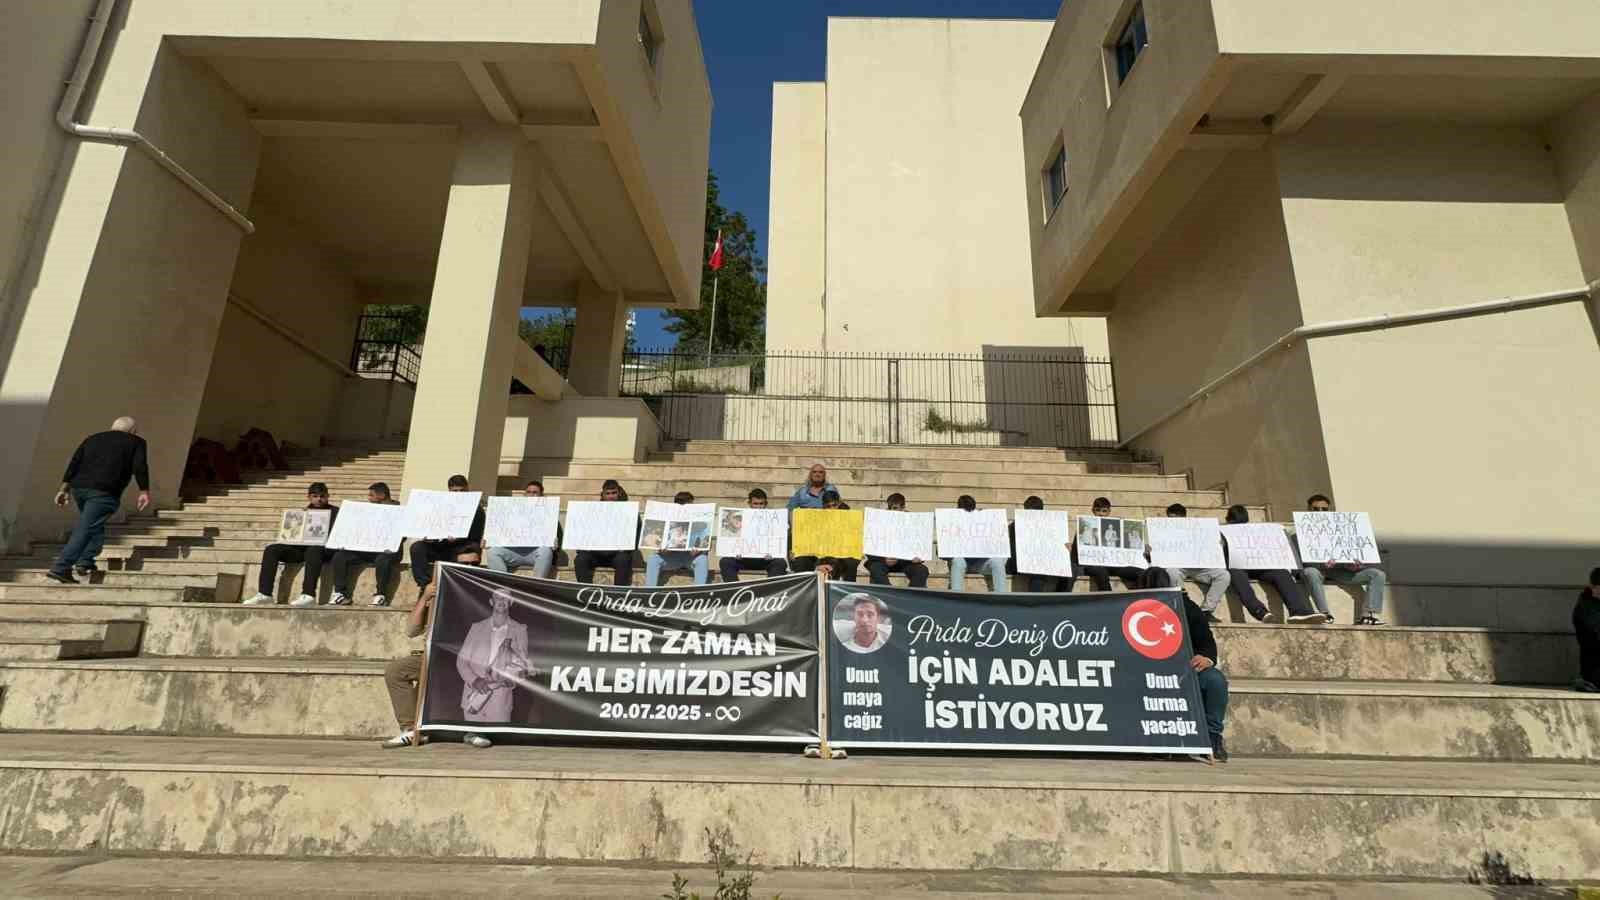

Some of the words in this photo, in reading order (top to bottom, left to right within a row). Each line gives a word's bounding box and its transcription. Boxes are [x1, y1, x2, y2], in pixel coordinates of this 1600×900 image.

[577, 586, 642, 613] Arda
[641, 589, 722, 625] Deniz
[726, 586, 789, 617] Onat
[587, 627, 652, 654] HER
[660, 630, 776, 657] ZAMAN
[907, 615, 972, 646] Arda
[974, 618, 1048, 656] Deniz
[1052, 620, 1109, 649] Onat
[845, 667, 880, 683] Unut
[908, 649, 978, 692] İÇİN
[988, 656, 1115, 687] ADALET
[550, 662, 807, 698] KALBİMİZDESİN
[1145, 672, 1180, 689] Unut
[843, 692, 882, 708] maya
[1143, 694, 1188, 712] turma
[599, 703, 701, 721] 20.07.2025
[924, 692, 1109, 731] İSTİYORUZ
[844, 712, 882, 730] cağız
[1141, 718, 1198, 736] yacağız
